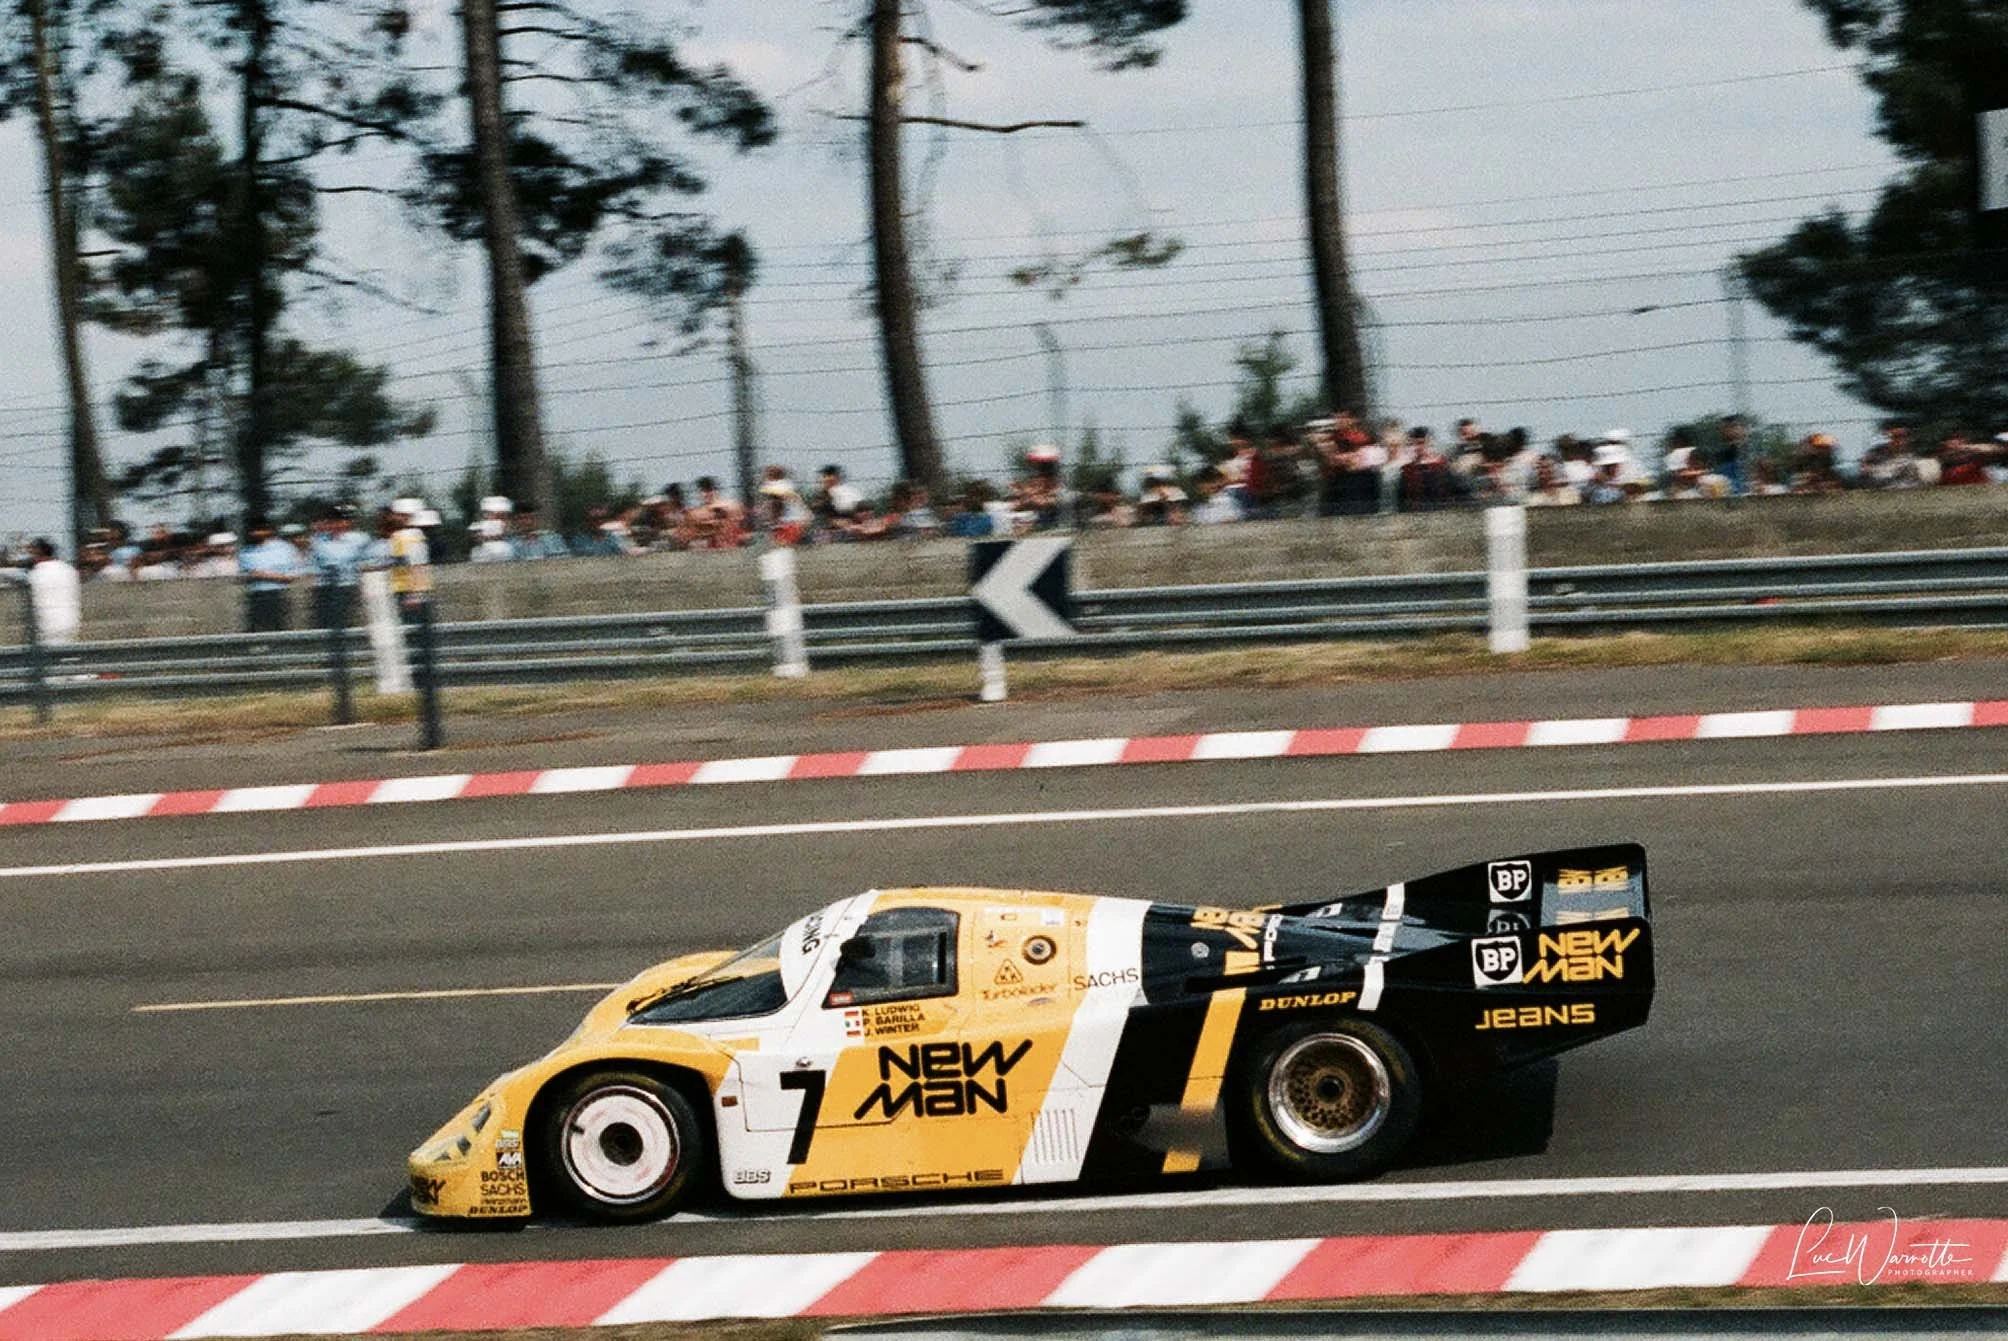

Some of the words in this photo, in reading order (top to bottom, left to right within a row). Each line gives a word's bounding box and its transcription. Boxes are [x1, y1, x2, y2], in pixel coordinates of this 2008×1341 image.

[1497, 869, 1527, 891] BP
[1481, 947, 1516, 973] BP
[1074, 967, 1139, 991] SACHS
[1260, 991, 1356, 1010] DUNLOP
[875, 1004, 920, 1015] LUDWIG
[875, 1013, 925, 1025] BARILLA
[875, 1023, 919, 1034] WINTER
[780, 1069, 826, 1164] 7
[481, 1170, 525, 1182] BOSCH
[734, 1168, 771, 1184] BBS
[789, 1169, 1004, 1193] PORSCHE
[480, 1182, 526, 1196] SACHS
